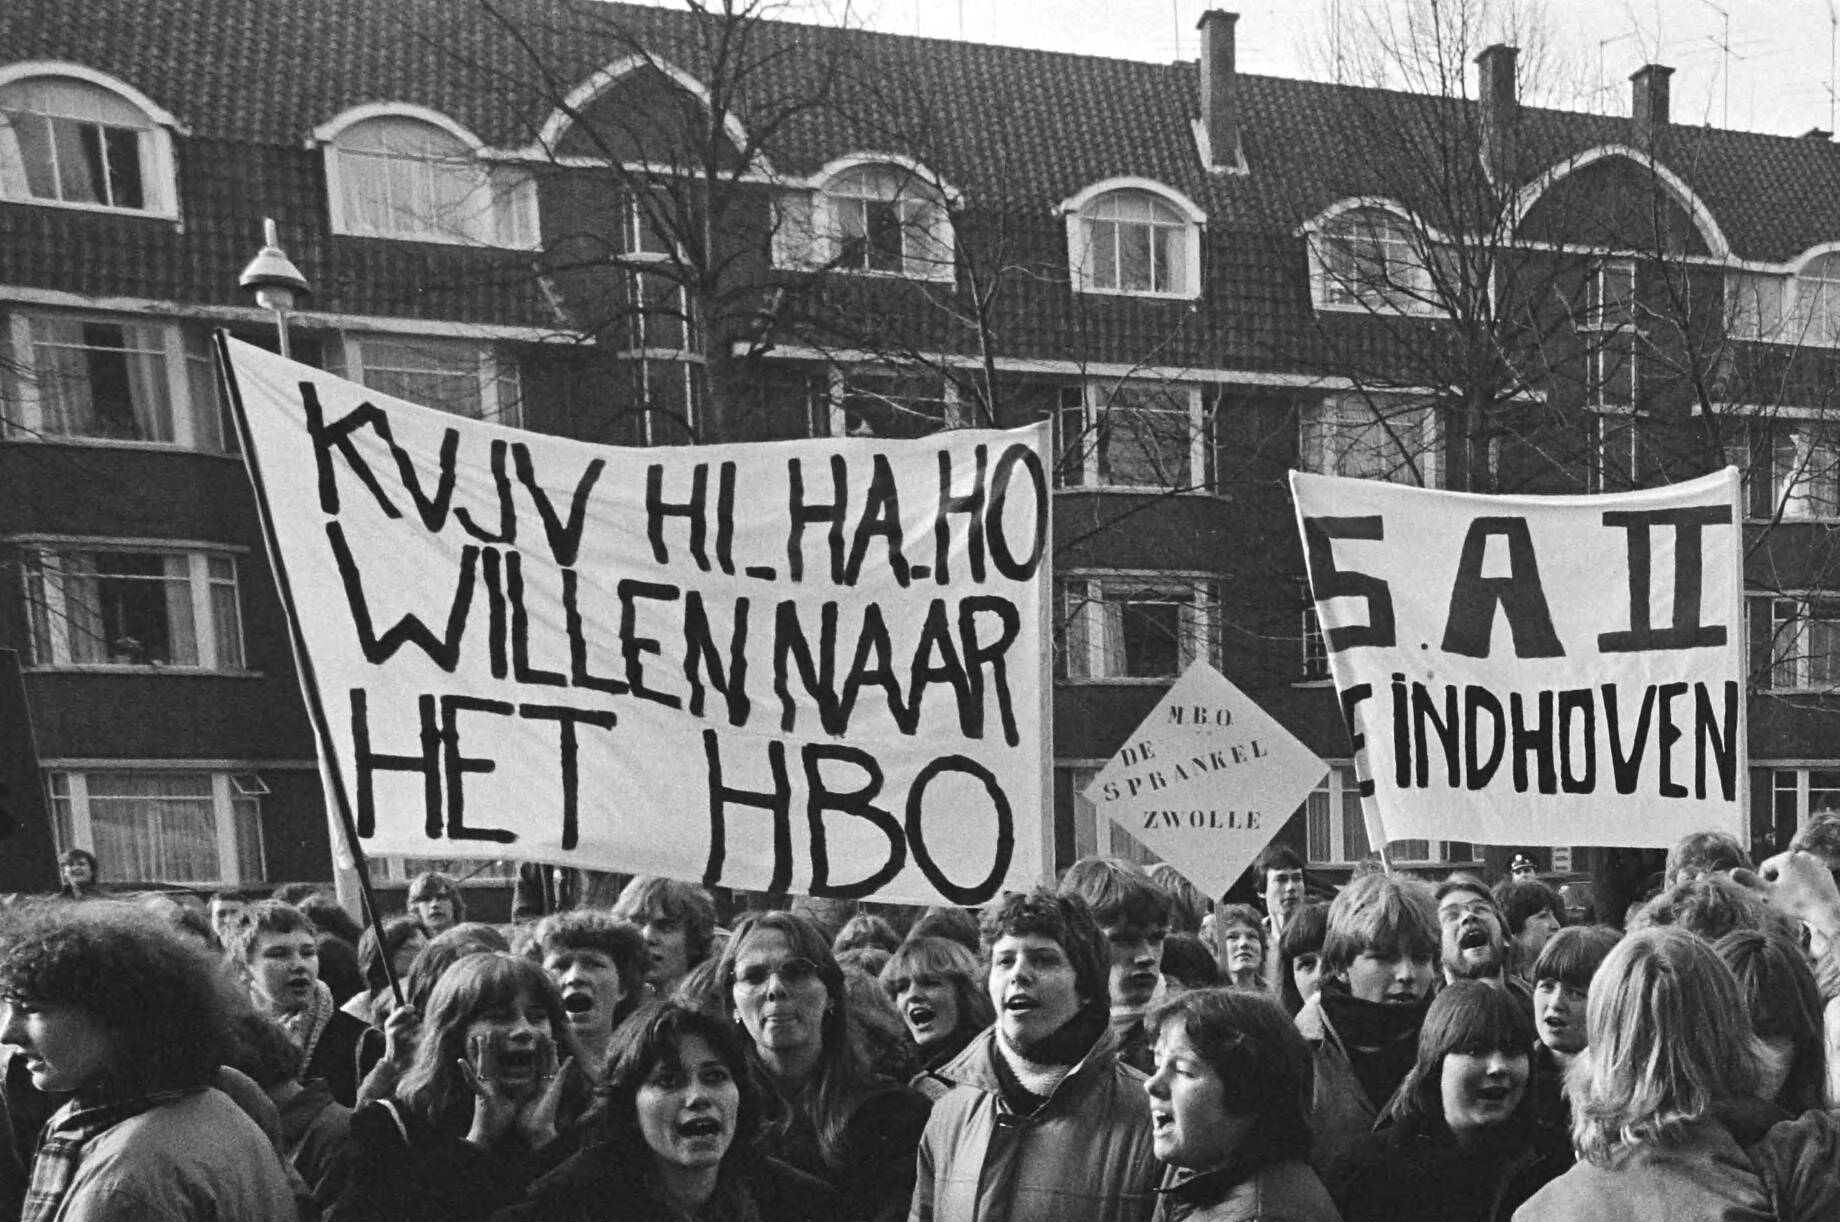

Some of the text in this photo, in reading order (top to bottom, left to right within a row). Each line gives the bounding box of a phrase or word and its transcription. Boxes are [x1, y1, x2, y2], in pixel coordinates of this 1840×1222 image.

[298, 381, 606, 567] KVJV
[325, 520, 1021, 747] WILLEN NAAR
[351, 687, 1015, 905] HET HBO
[1103, 740, 1268, 802] SPRANKEL
[1120, 740, 1156, 768] DE
[1143, 810, 1262, 830] ZWOLLE
